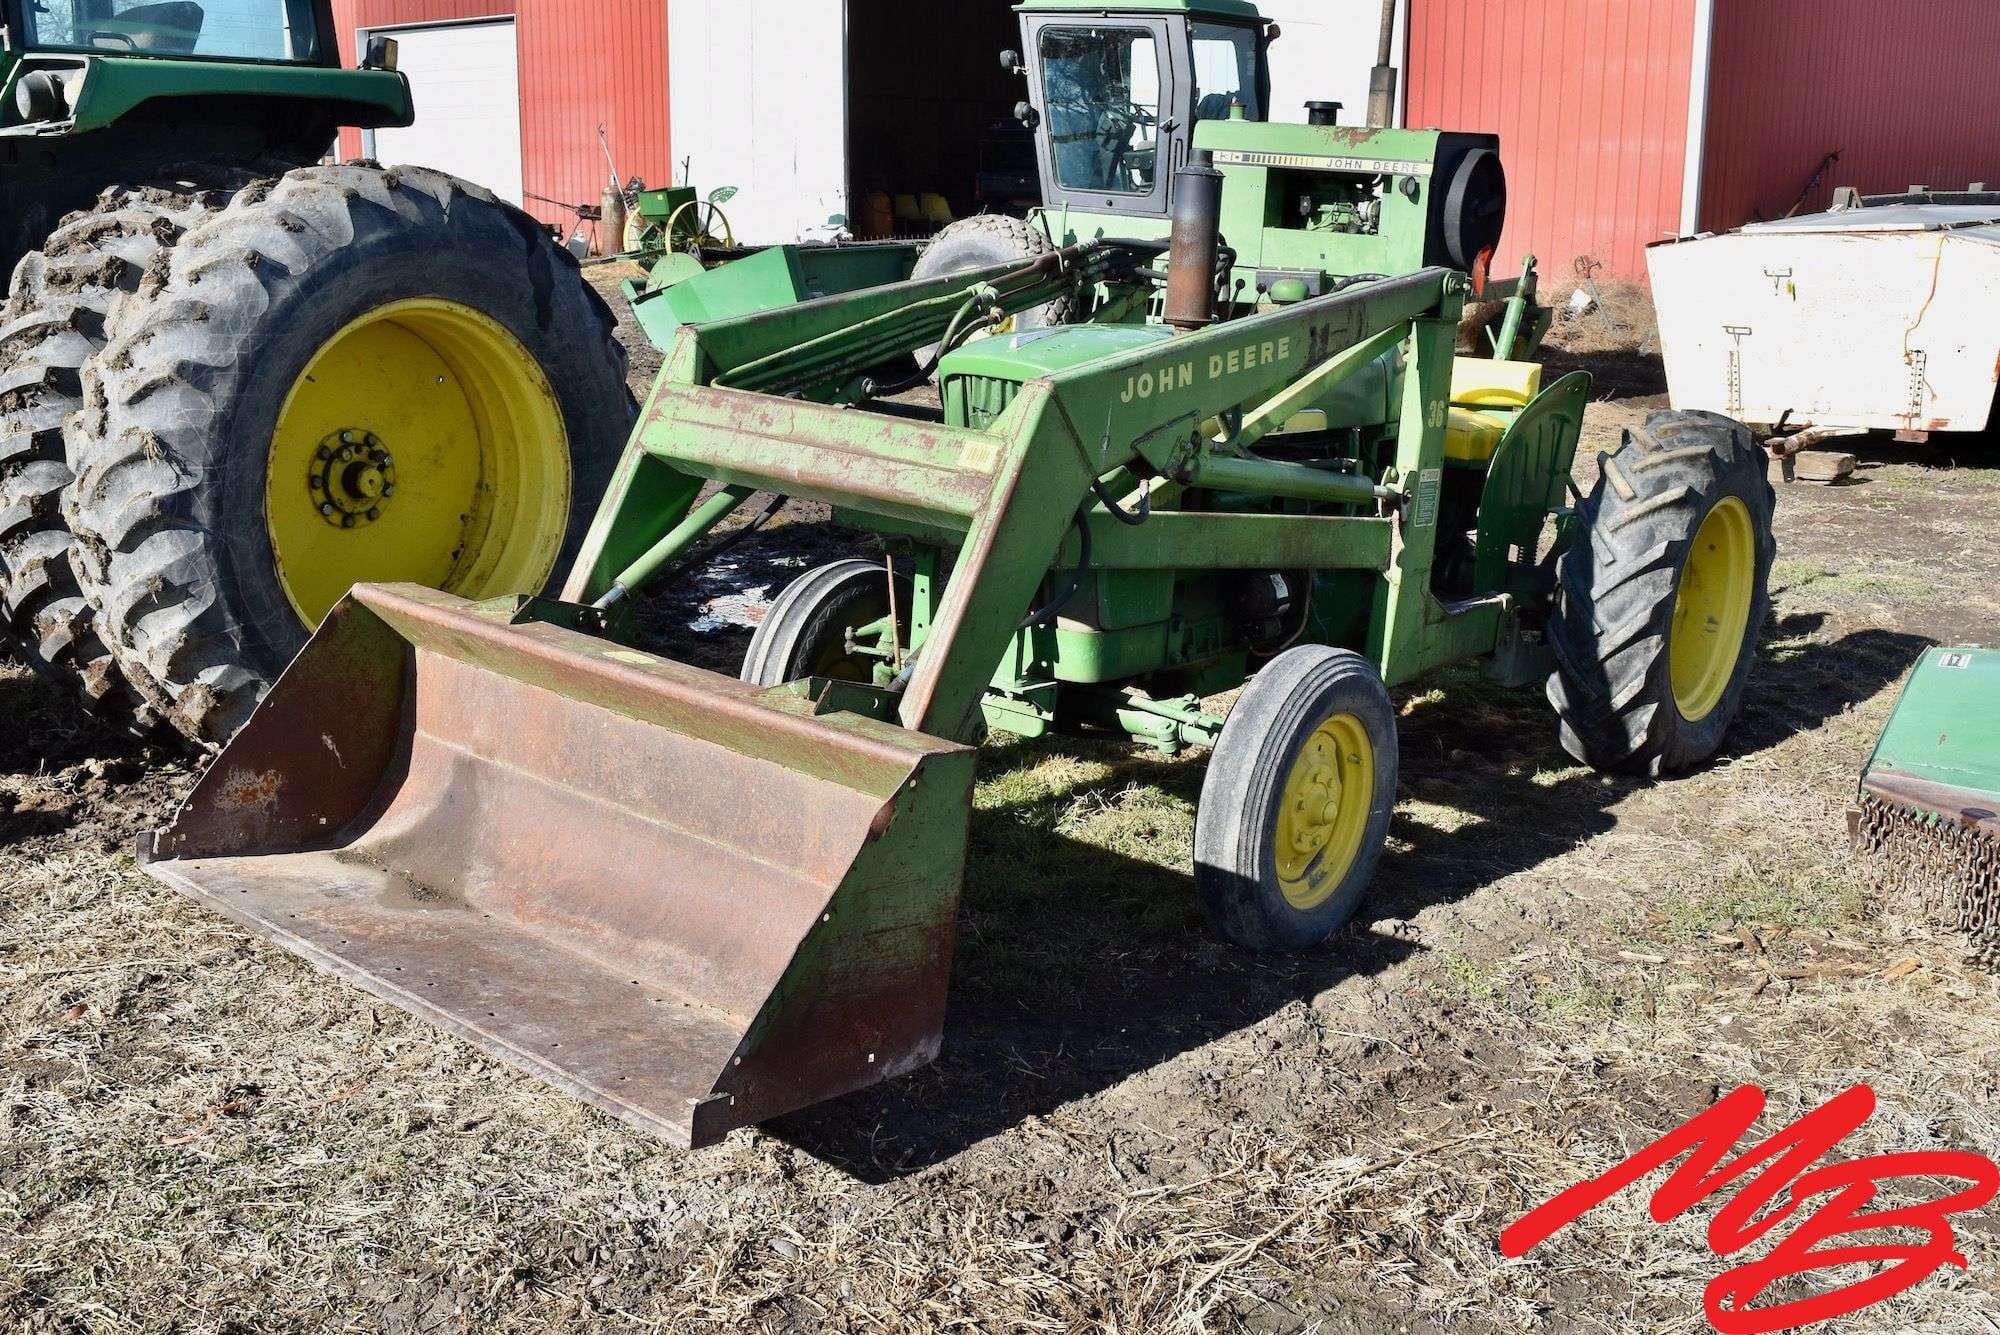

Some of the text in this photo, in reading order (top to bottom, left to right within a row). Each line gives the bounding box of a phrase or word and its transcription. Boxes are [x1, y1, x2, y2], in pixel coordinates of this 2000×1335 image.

[1326, 158, 1420, 174] JOHN DEERE
[1120, 336, 1291, 404] JOHN DEERE
[1427, 400, 1445, 428] 36
